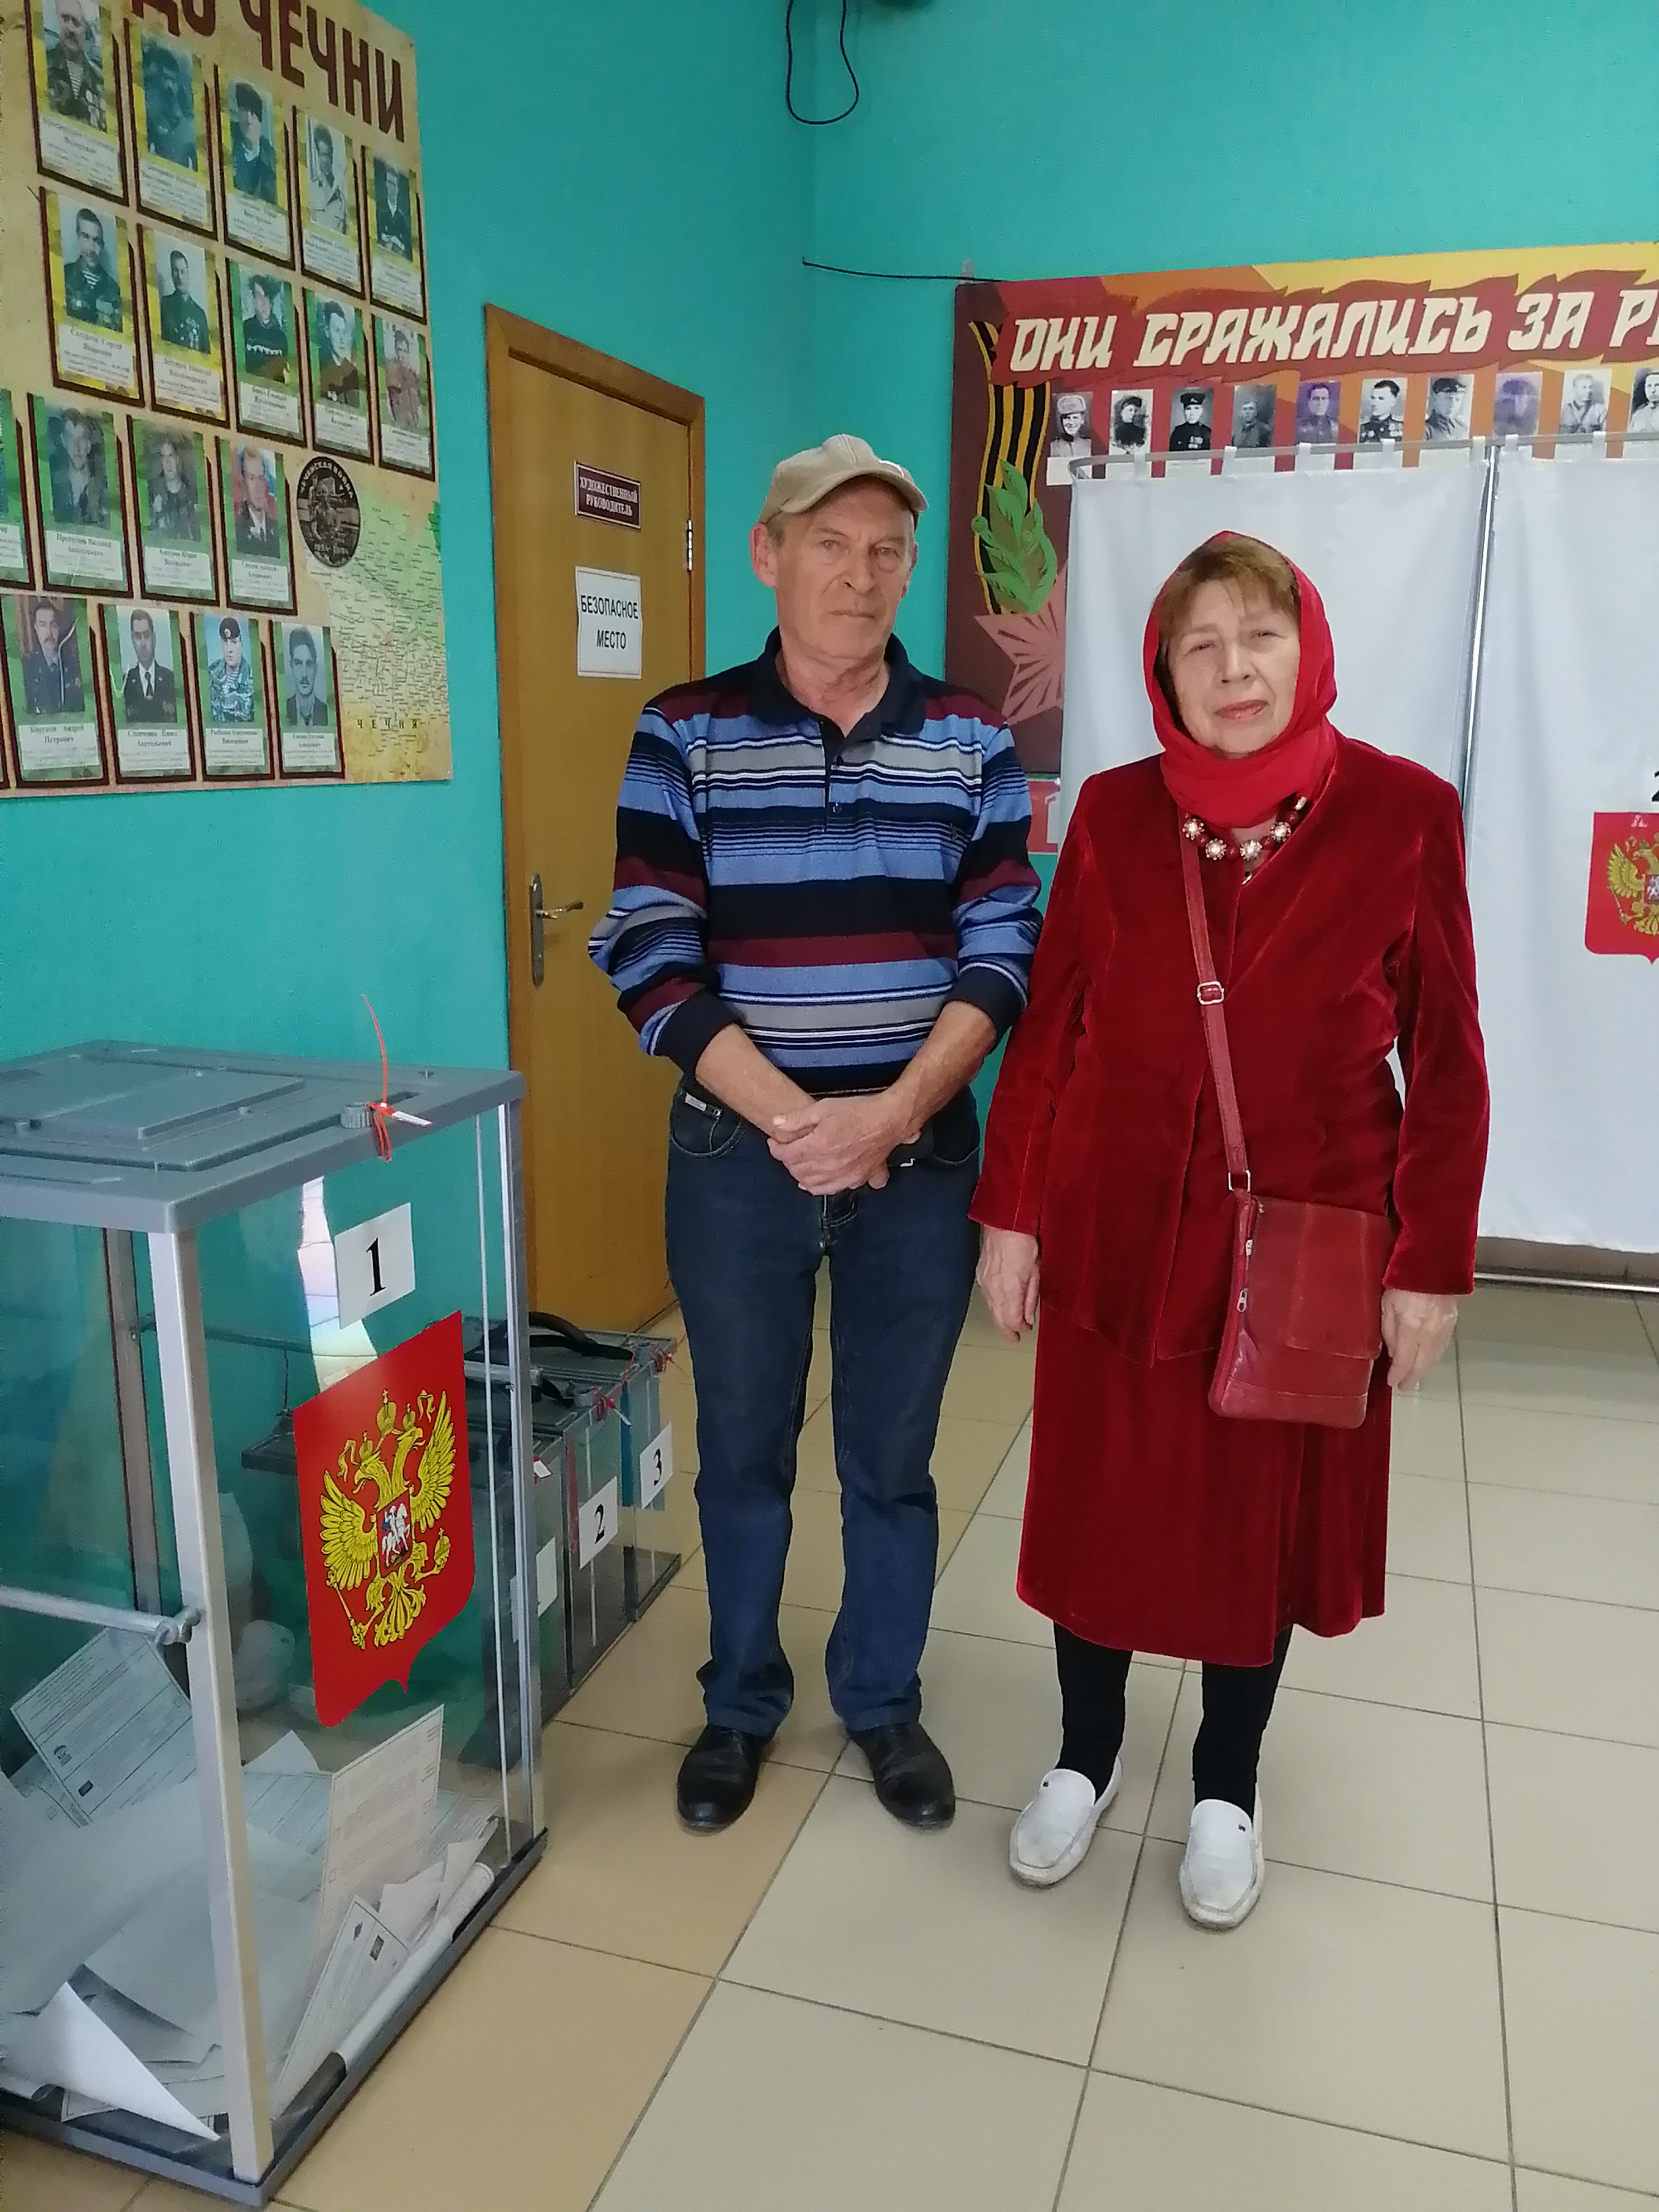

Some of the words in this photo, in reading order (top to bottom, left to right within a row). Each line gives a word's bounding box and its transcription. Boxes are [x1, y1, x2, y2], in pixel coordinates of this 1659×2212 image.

[239, 0, 405, 143] ЧЕЧНИ
[1010, 315, 1118, 372] ОНИ
[1132, 297, 1492, 367] СРАЖАЛИСЬ
[1507, 292, 1595, 351] ЗА
[1609, 289, 1659, 348] Р
[580, 476, 638, 503] ХУДОЖЕСТВЕННЫЙ
[586, 493, 633, 516] РУКОВОДИТЕЛЬ
[580, 594, 639, 619] БЕЗОПАСНОЕ
[596, 629, 626, 649] МЕСТО
[366, 1236, 386, 1297] 1
[653, 1448, 662, 1486] 3
[594, 1504, 605, 1544] 2
